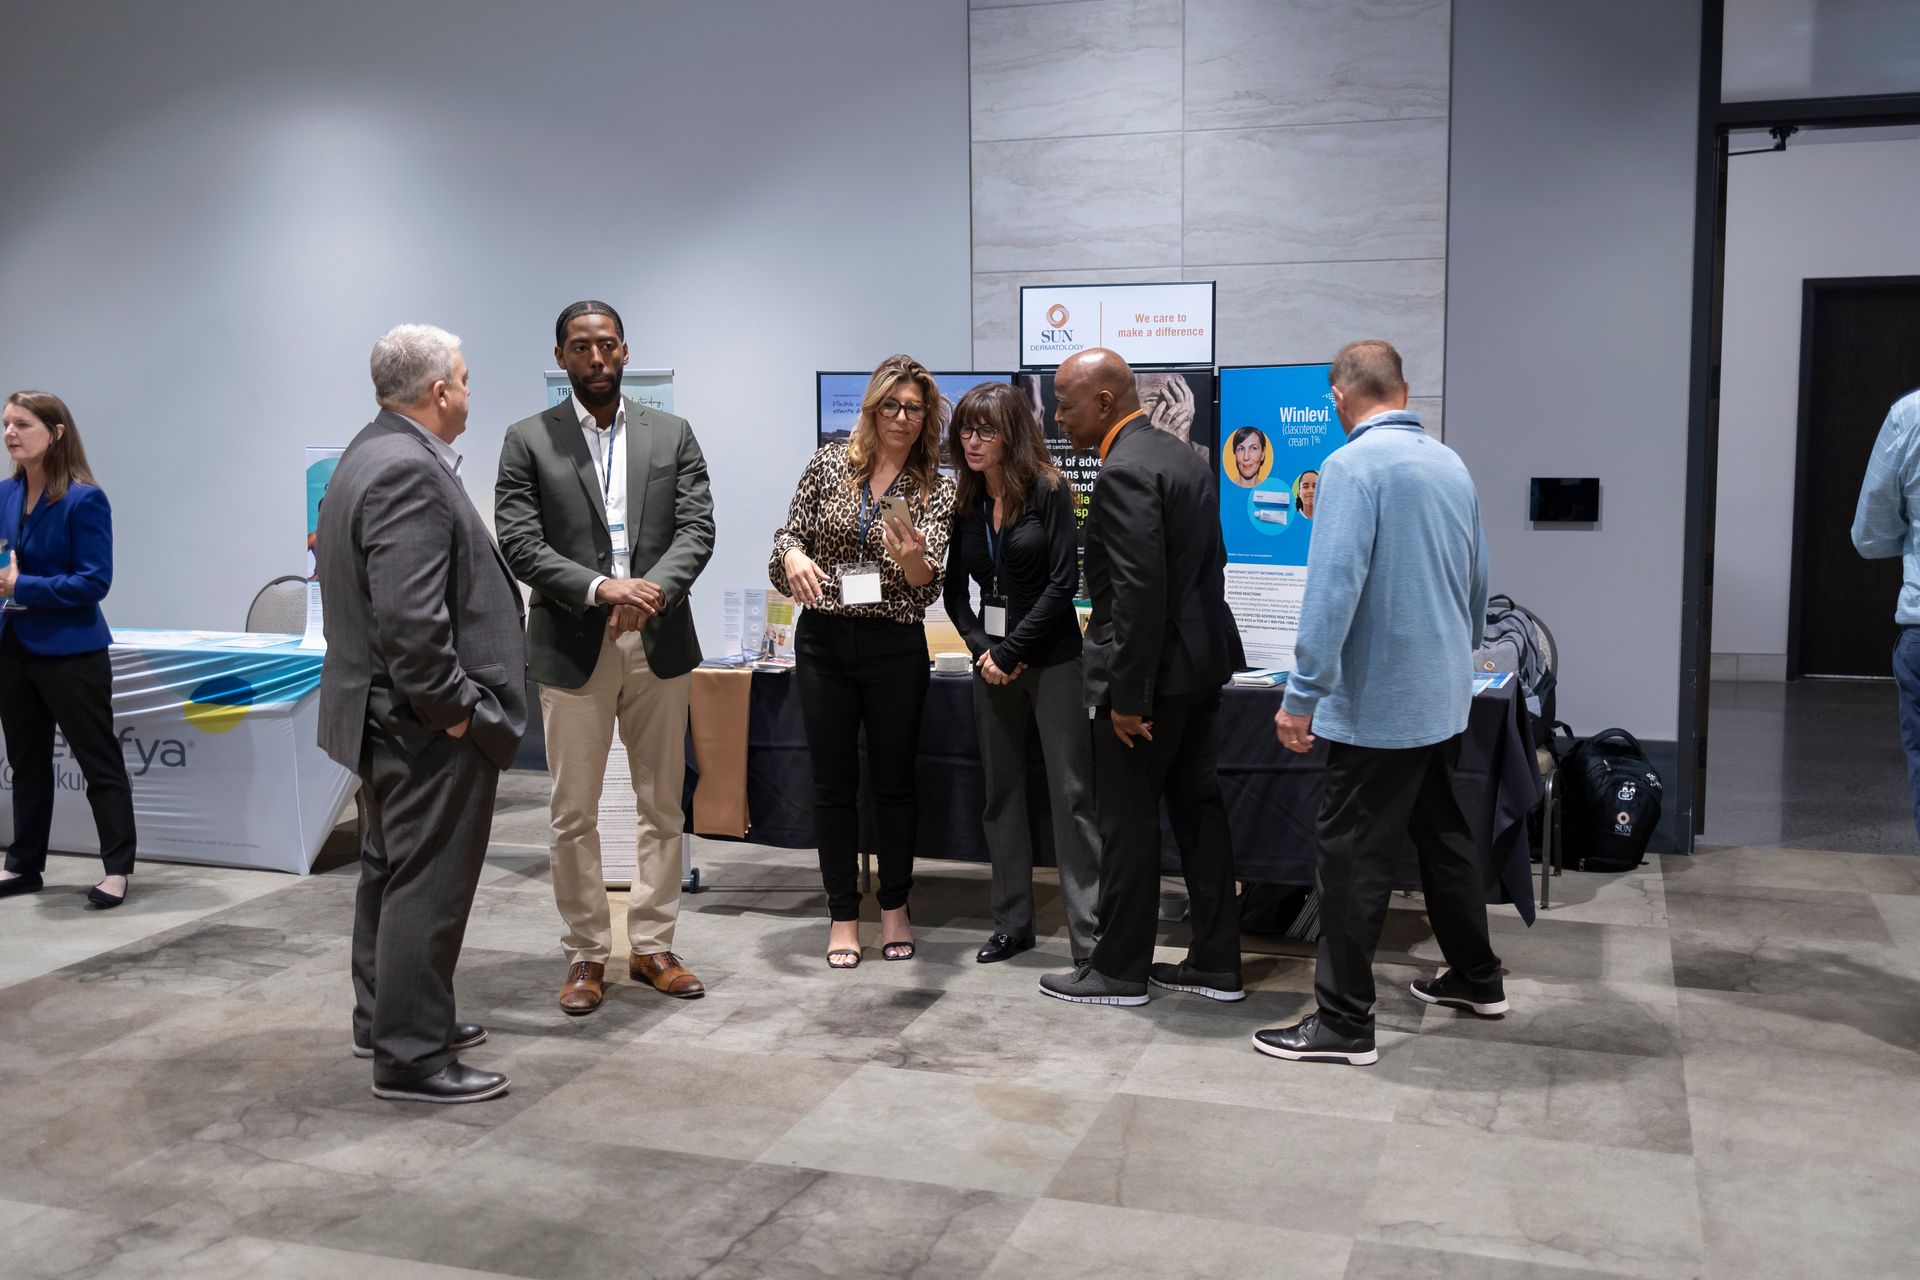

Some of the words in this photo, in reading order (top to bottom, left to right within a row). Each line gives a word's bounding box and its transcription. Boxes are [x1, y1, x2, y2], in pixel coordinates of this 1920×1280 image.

[1135, 313, 1150, 323] We
[1153, 314, 1174, 323] care
[1177, 313, 1187, 322] to
[1041, 329, 1074, 343] SUN
[1118, 327, 1144, 338] make
[1146, 329, 1153, 337] a
[1155, 327, 1204, 337] difference
[556, 387, 573, 396] TRE
[1282, 422, 1327, 436] (clascoterone)
[1288, 437, 1309, 447] cream
[1311, 435, 1321, 446] 1%
[1065, 456, 1076, 467] of
[1078, 456, 1103, 467] adve
[1081, 471, 1099, 479] we
[1071, 481, 1094, 492] mod
[1615, 824, 1632, 833] SUN
